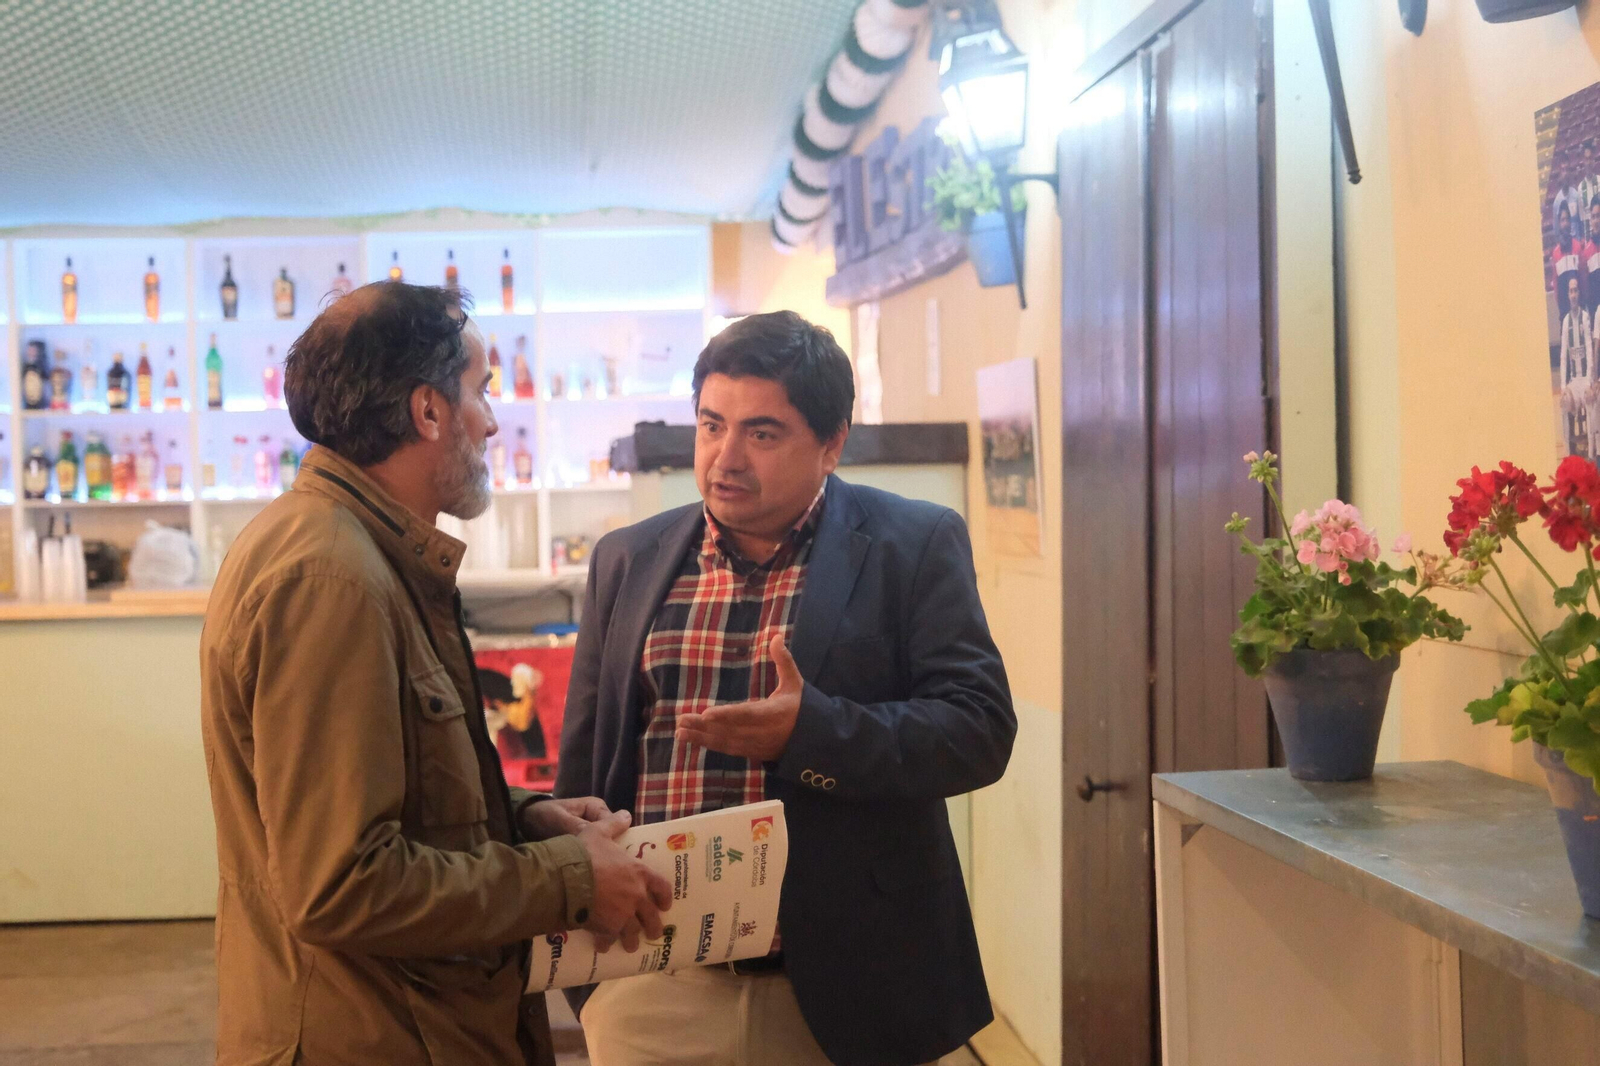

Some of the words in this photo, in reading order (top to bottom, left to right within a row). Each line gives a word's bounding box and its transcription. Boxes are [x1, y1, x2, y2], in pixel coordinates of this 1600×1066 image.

[713, 836, 725, 882] sadeco
[753, 845, 759, 856] de
[759, 843, 768, 886] Diputación
[673, 855, 682, 900] CARCABUEY
[751, 857, 760, 888] Córdoba
[700, 912, 715, 955] EMACSA
